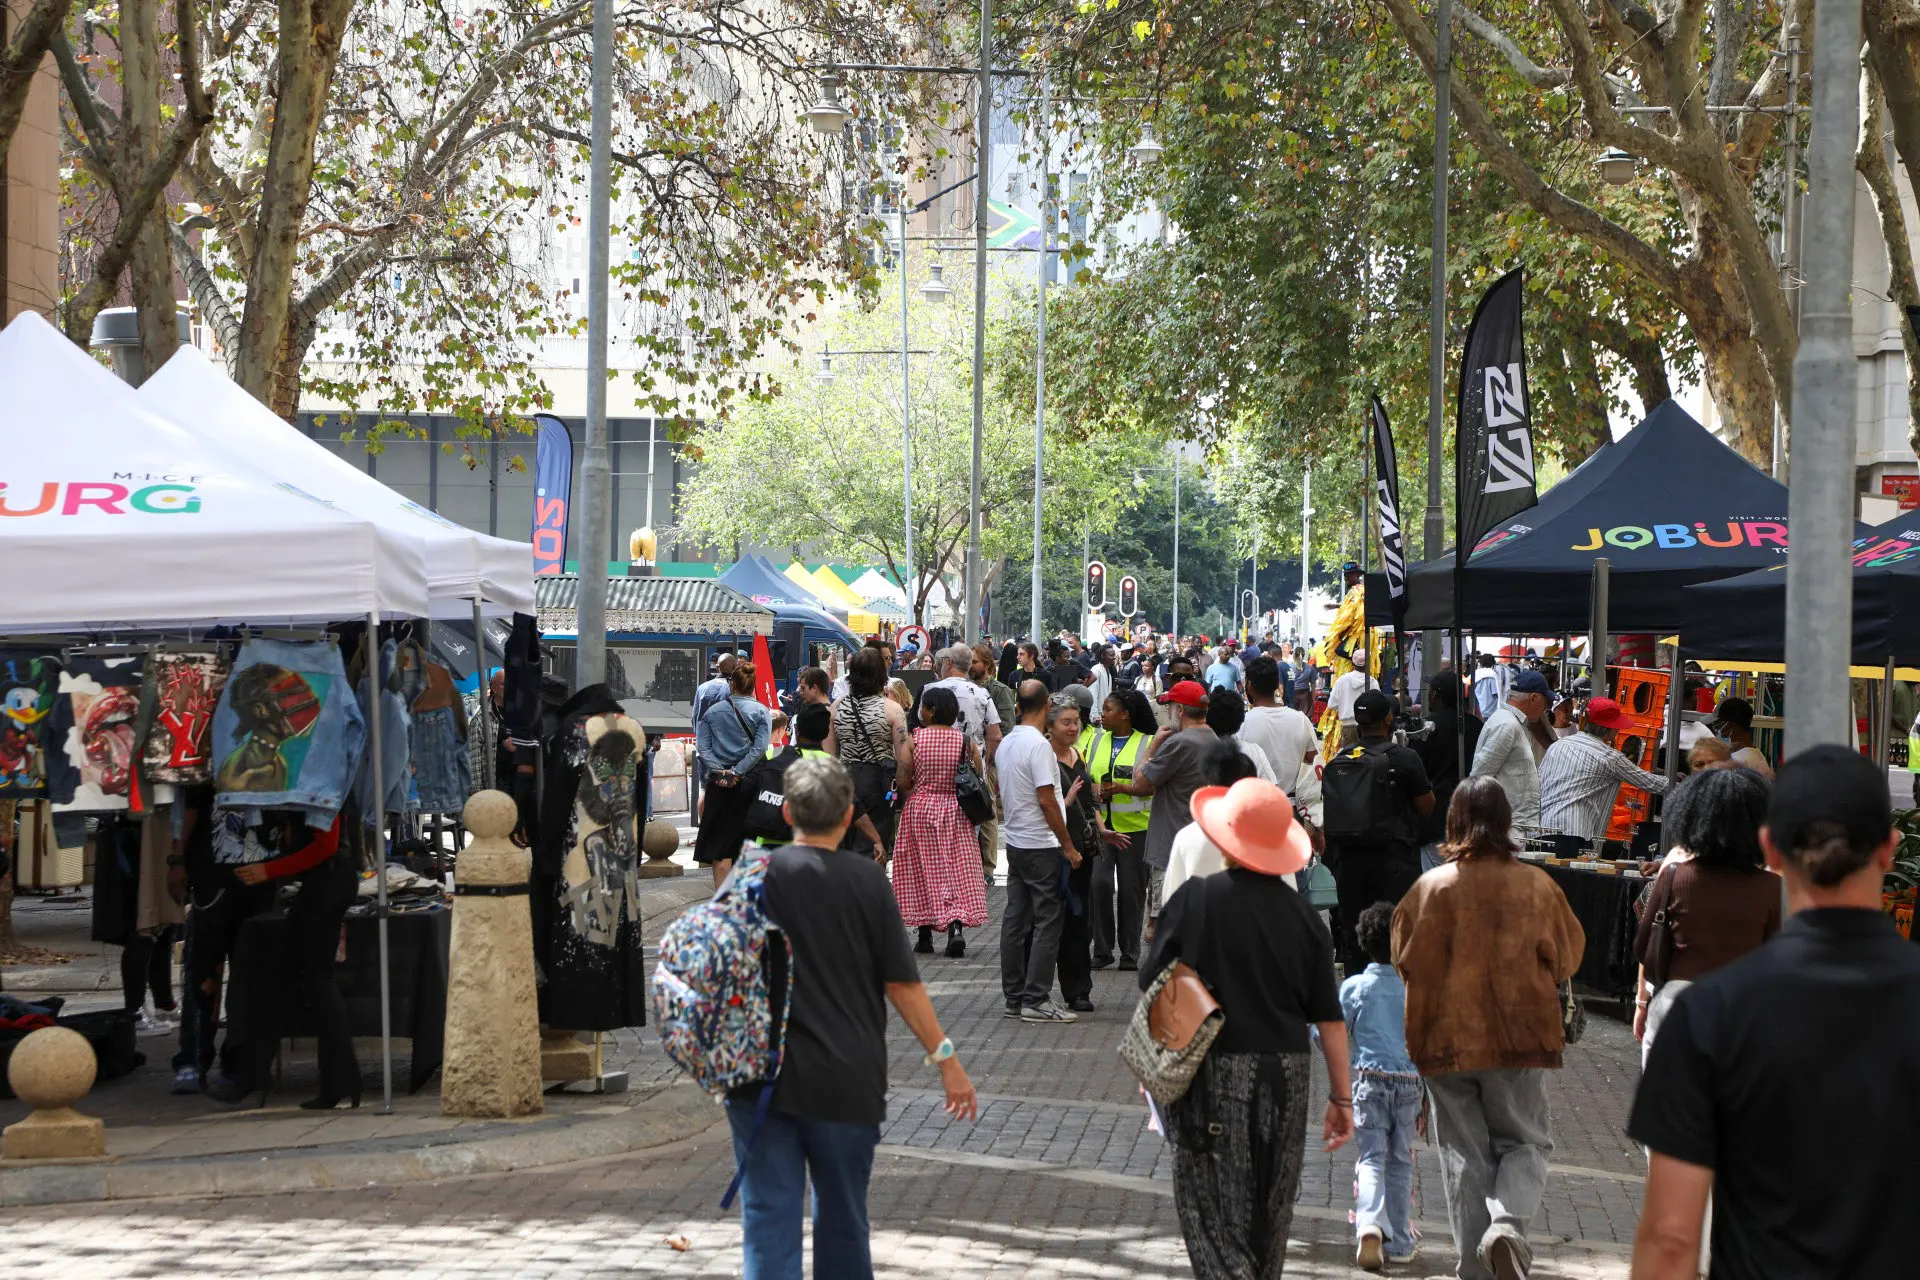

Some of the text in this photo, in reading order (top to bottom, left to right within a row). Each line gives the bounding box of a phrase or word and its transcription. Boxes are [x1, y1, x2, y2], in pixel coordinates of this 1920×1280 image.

[0, 482, 202, 517] URG
[1571, 522, 1789, 550] JOBUR
[758, 789, 785, 807] VANS
